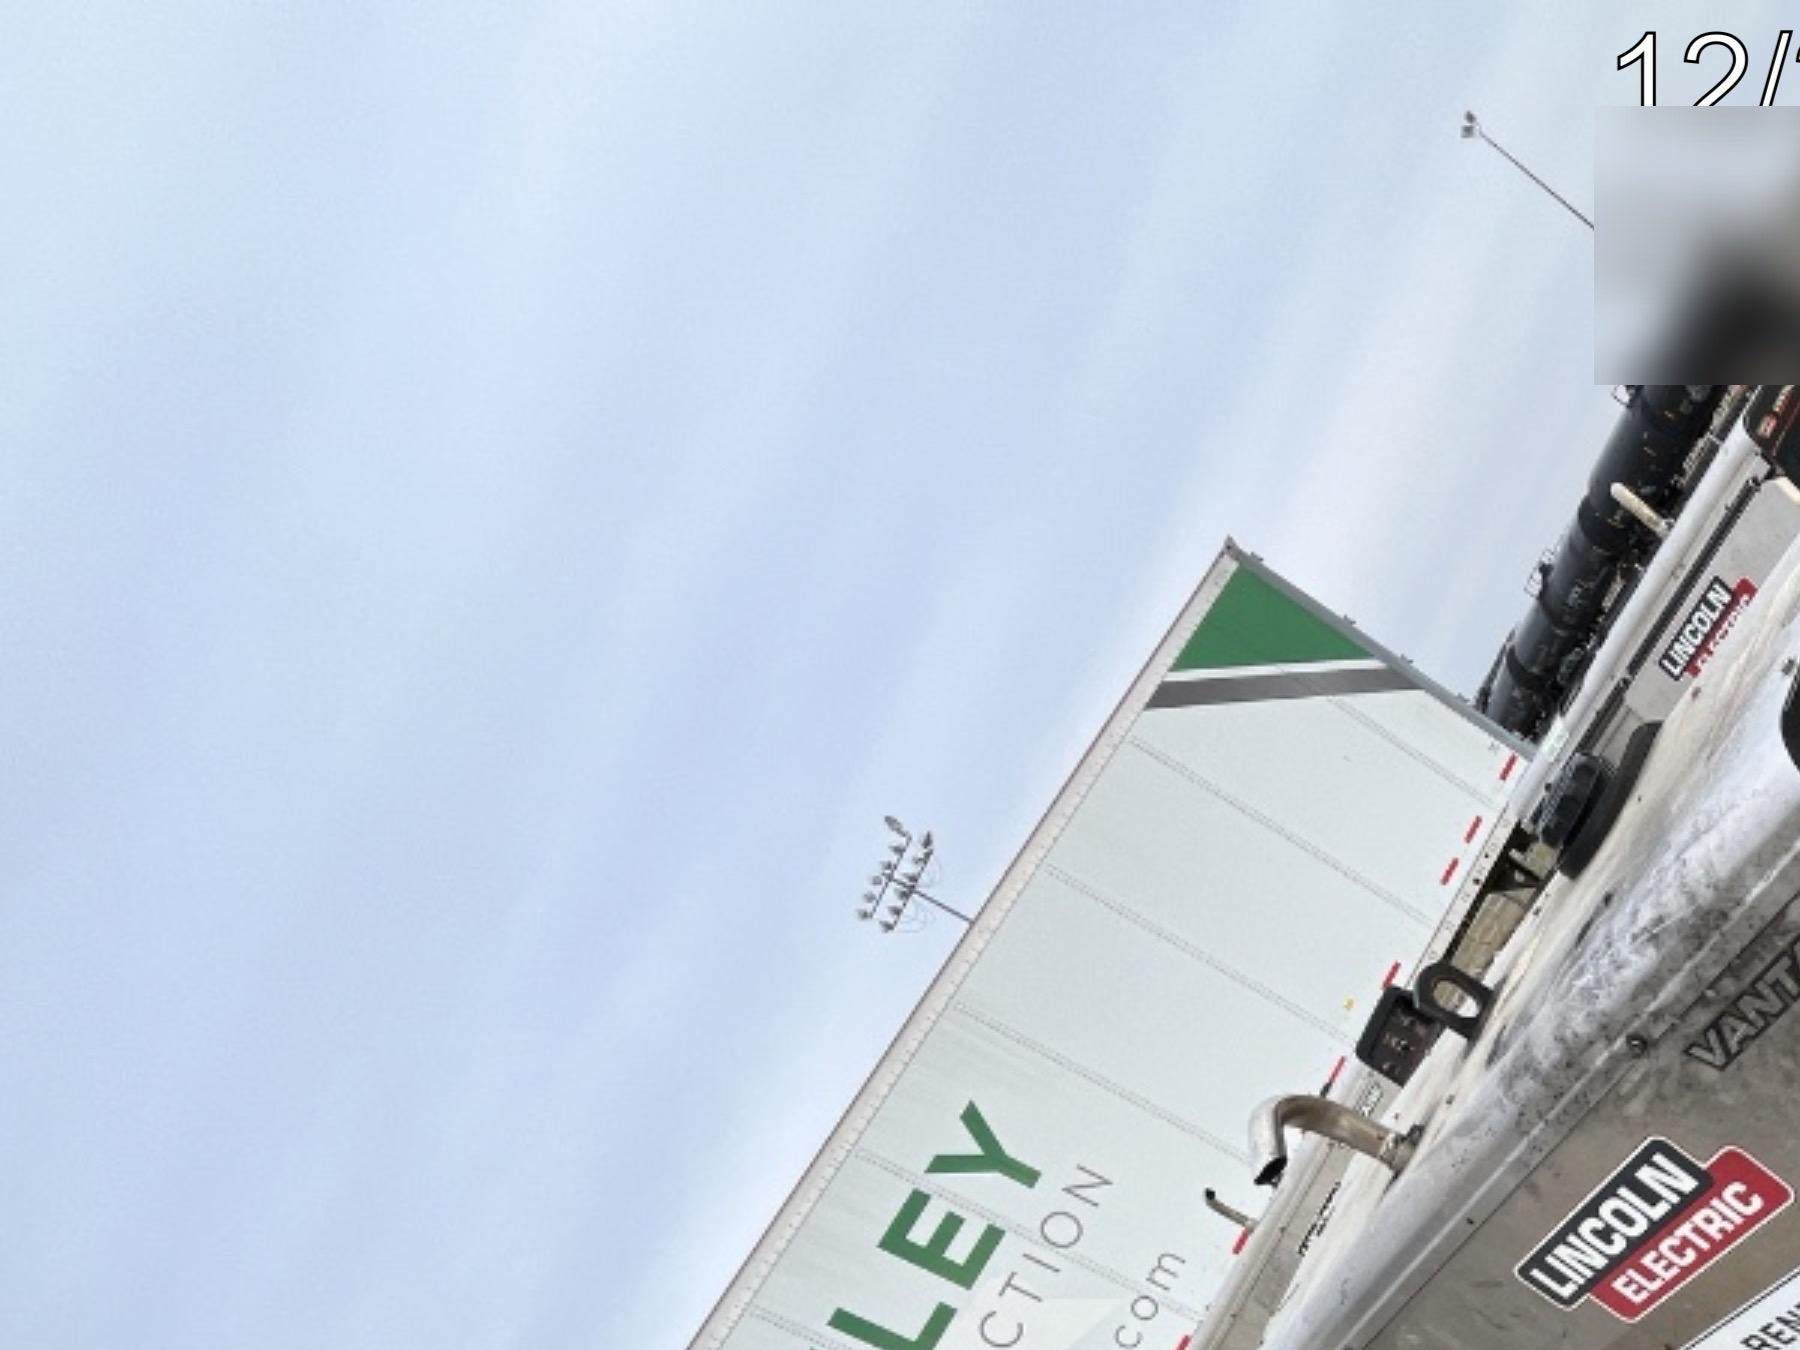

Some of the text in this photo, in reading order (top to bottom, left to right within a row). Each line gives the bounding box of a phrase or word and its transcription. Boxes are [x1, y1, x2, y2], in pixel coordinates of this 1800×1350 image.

[1662, 584, 1732, 676] LINCOLN
[1529, 1154, 1700, 1300] LINCOLN
[1610, 1180, 1765, 1307] ELECTRIC
